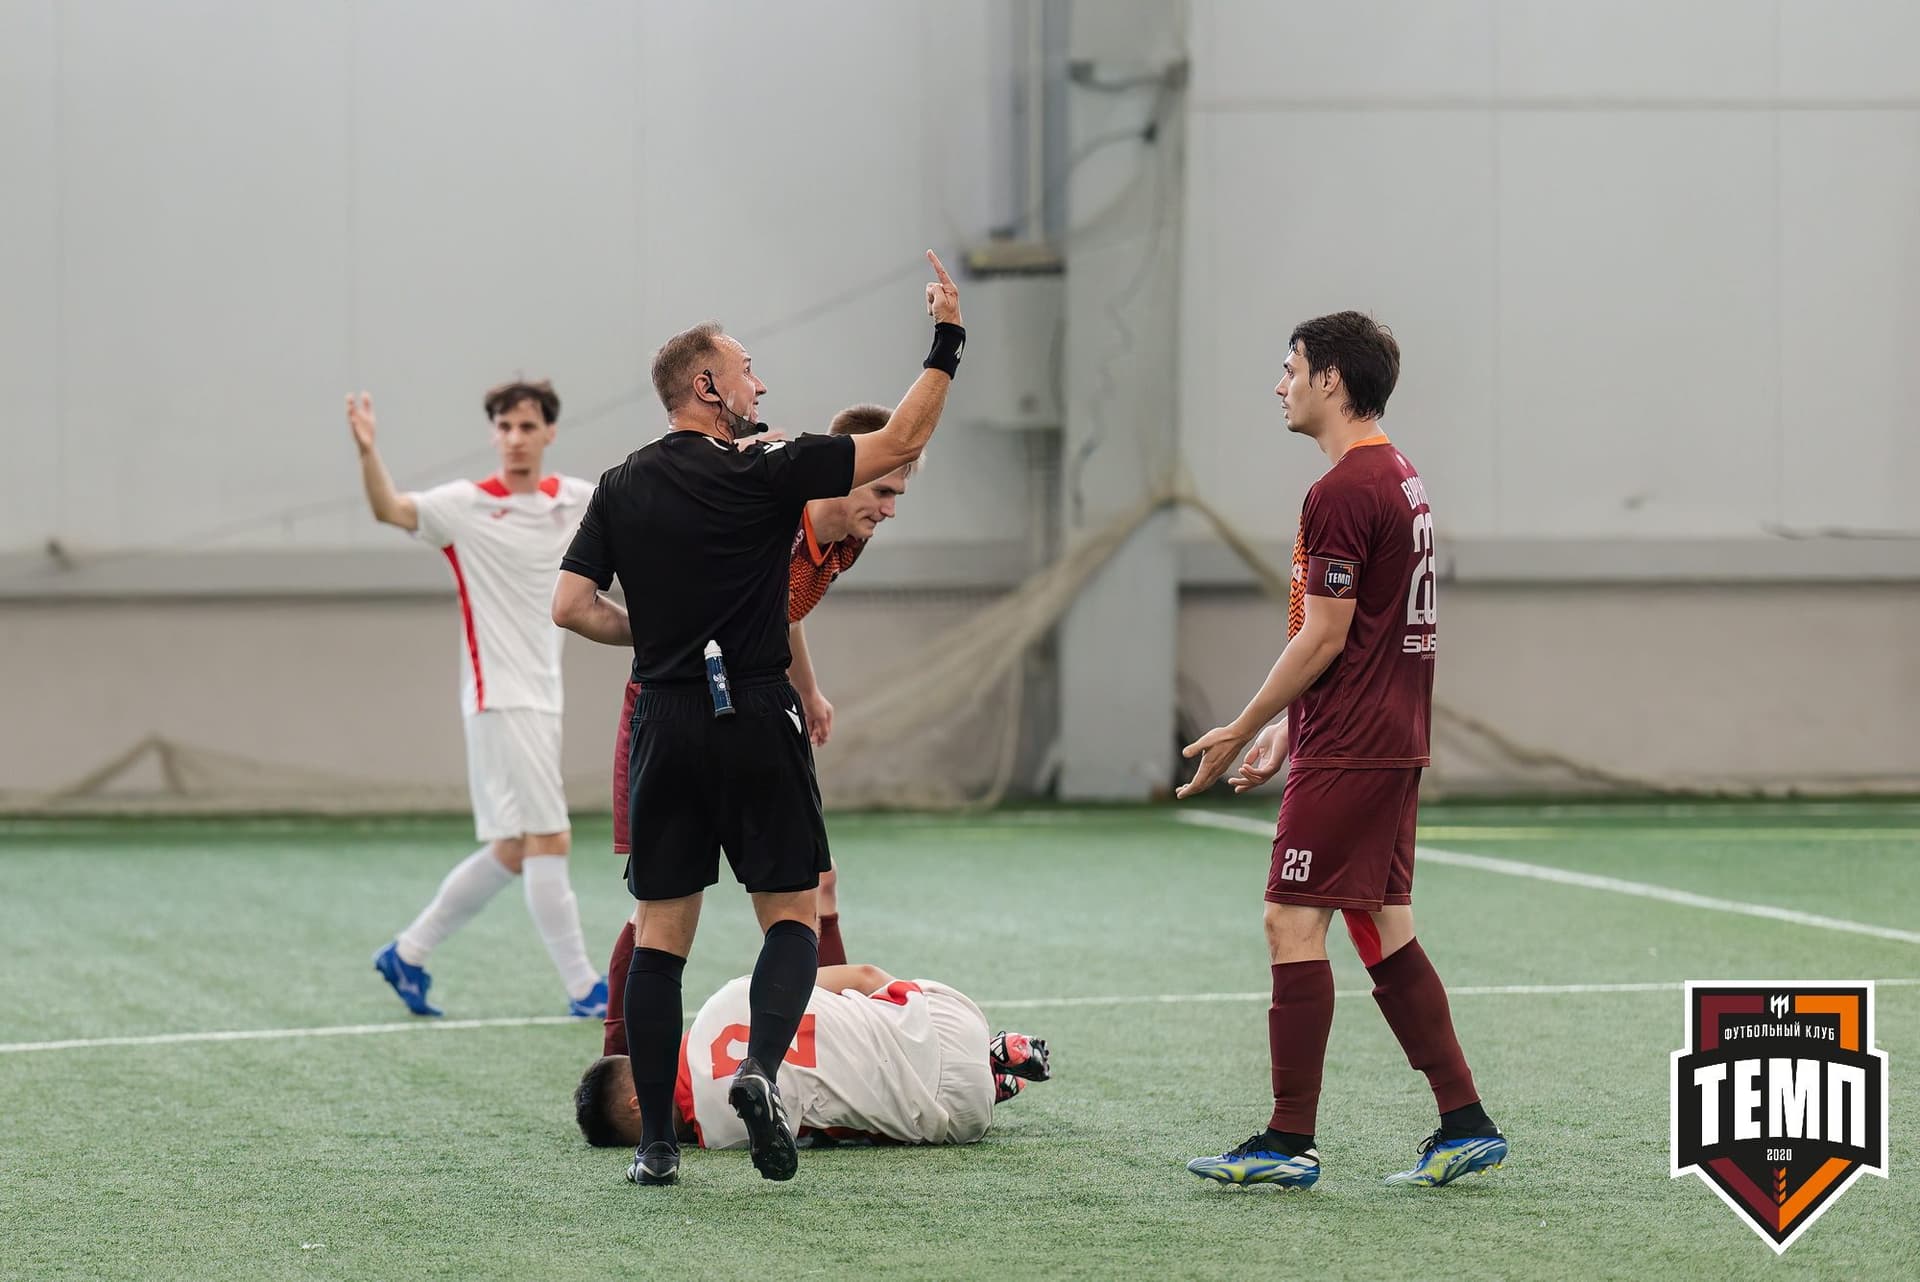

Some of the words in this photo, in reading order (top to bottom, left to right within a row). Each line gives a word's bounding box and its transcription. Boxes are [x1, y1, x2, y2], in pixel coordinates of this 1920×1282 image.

[1328, 572, 1351, 586] ТЕМП
[1407, 513, 1437, 625] 23
[1281, 848, 1312, 882] 23
